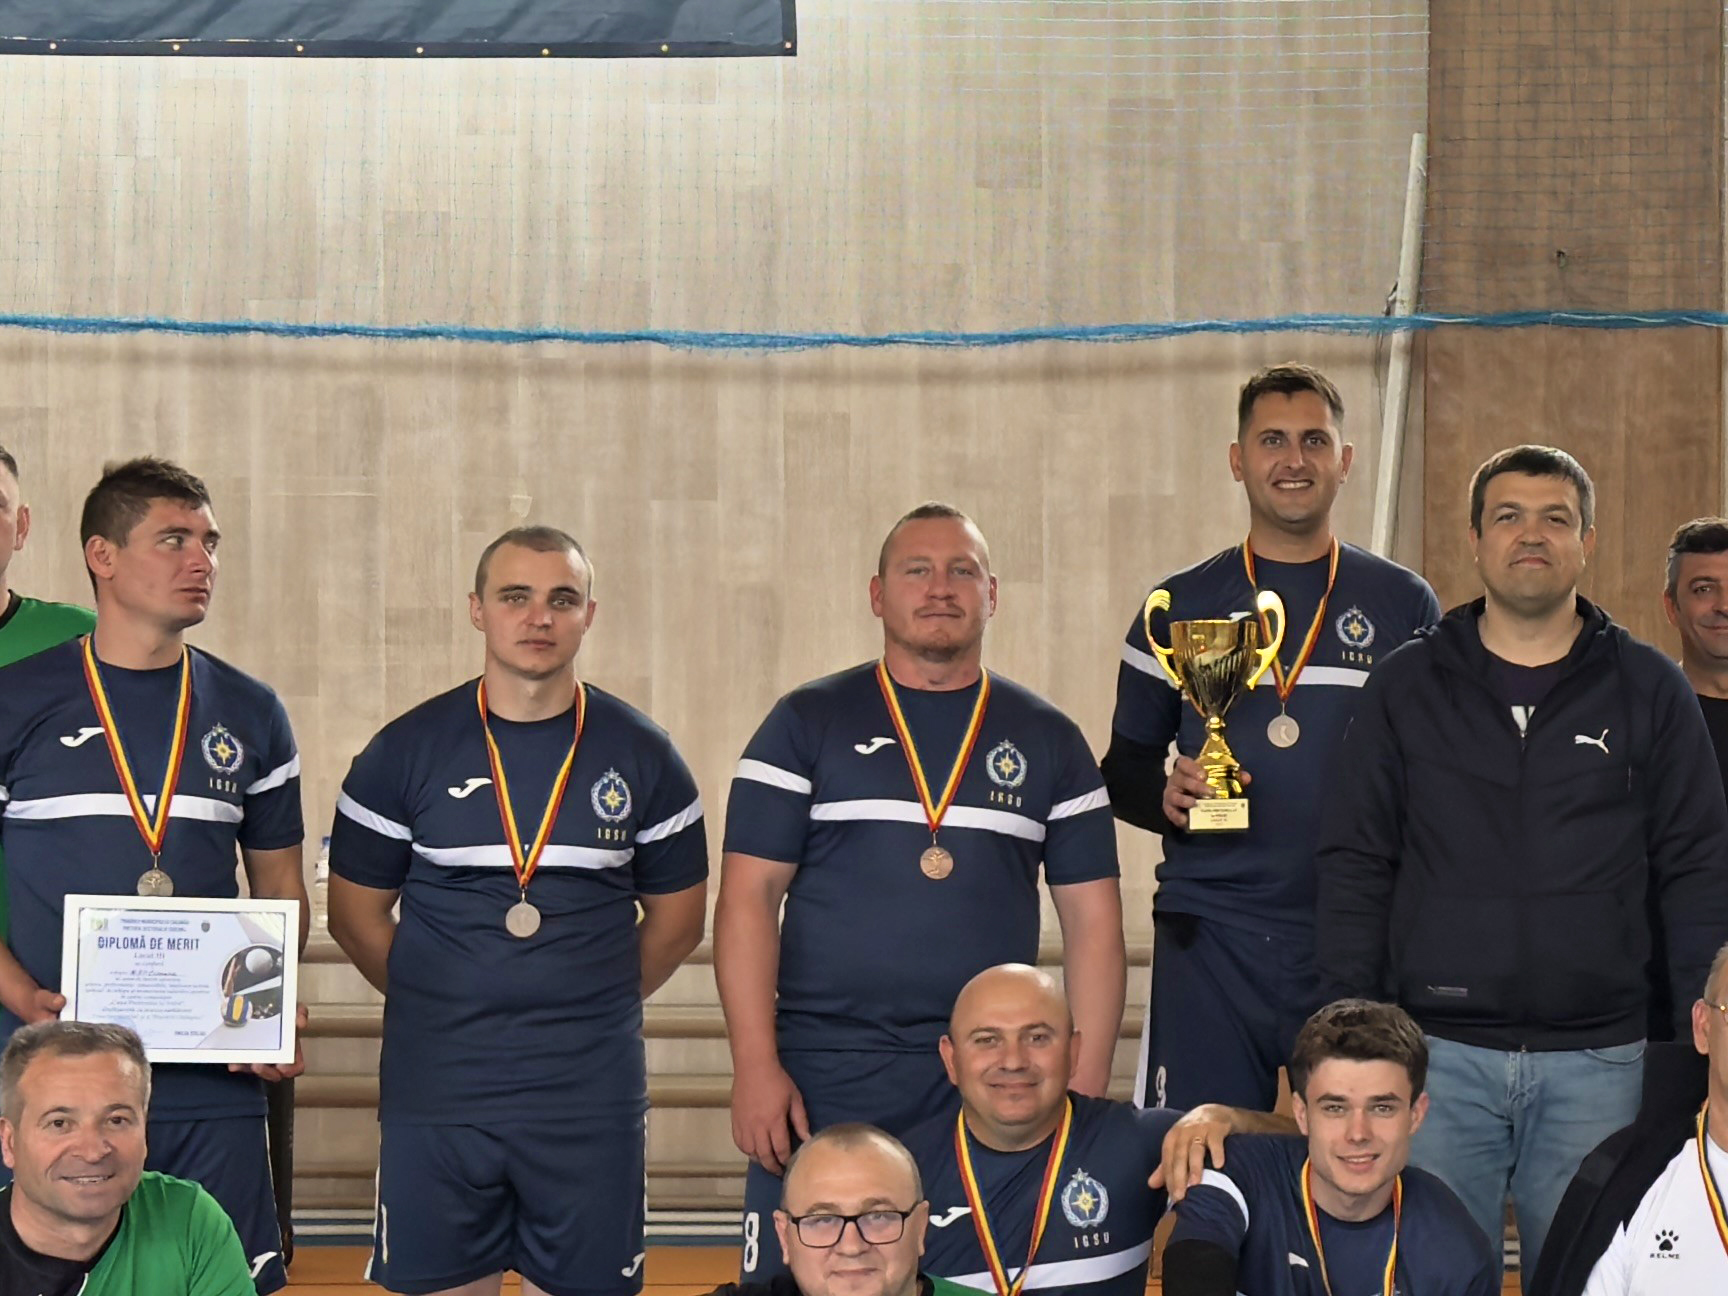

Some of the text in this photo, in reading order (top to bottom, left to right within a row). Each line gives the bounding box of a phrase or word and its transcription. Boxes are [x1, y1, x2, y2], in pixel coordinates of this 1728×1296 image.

[97, 935, 200, 951] DIPLOMĂ DE MERIT
[744, 1212, 759, 1272] 8
[1074, 1232, 1110, 1249] IGSU
